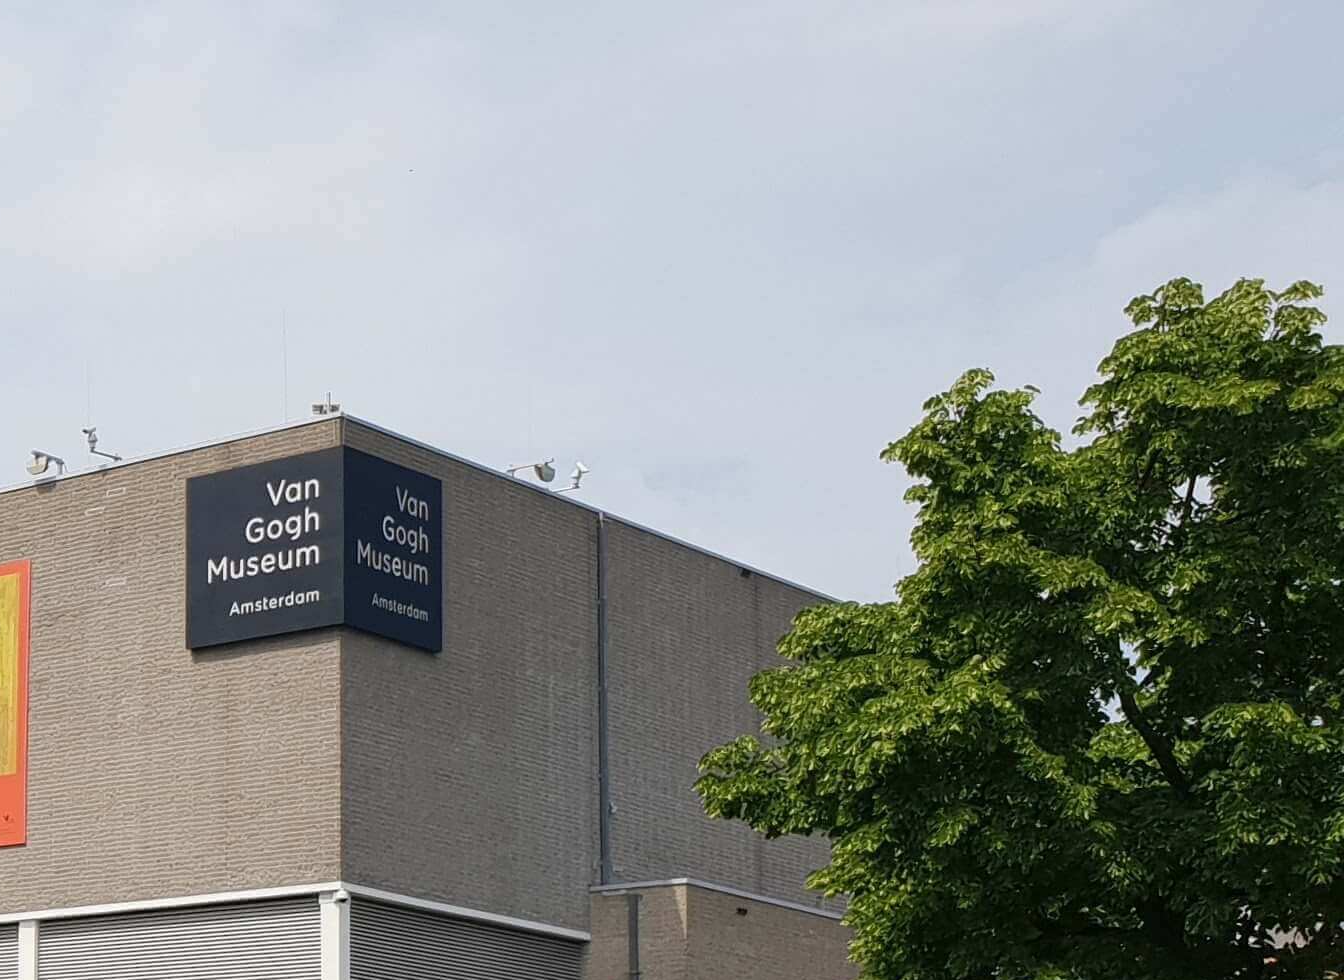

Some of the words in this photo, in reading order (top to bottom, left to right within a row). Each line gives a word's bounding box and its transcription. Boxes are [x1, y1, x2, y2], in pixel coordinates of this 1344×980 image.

[266, 478, 320, 506] Van
[395, 485, 429, 521] Van
[245, 506, 320, 544] Gogh
[382, 515, 429, 554] Gogh
[207, 544, 320, 584] Museum
[357, 539, 429, 586] Museum
[229, 589, 320, 617] Amsterdam
[371, 592, 429, 622] Amsterdam
